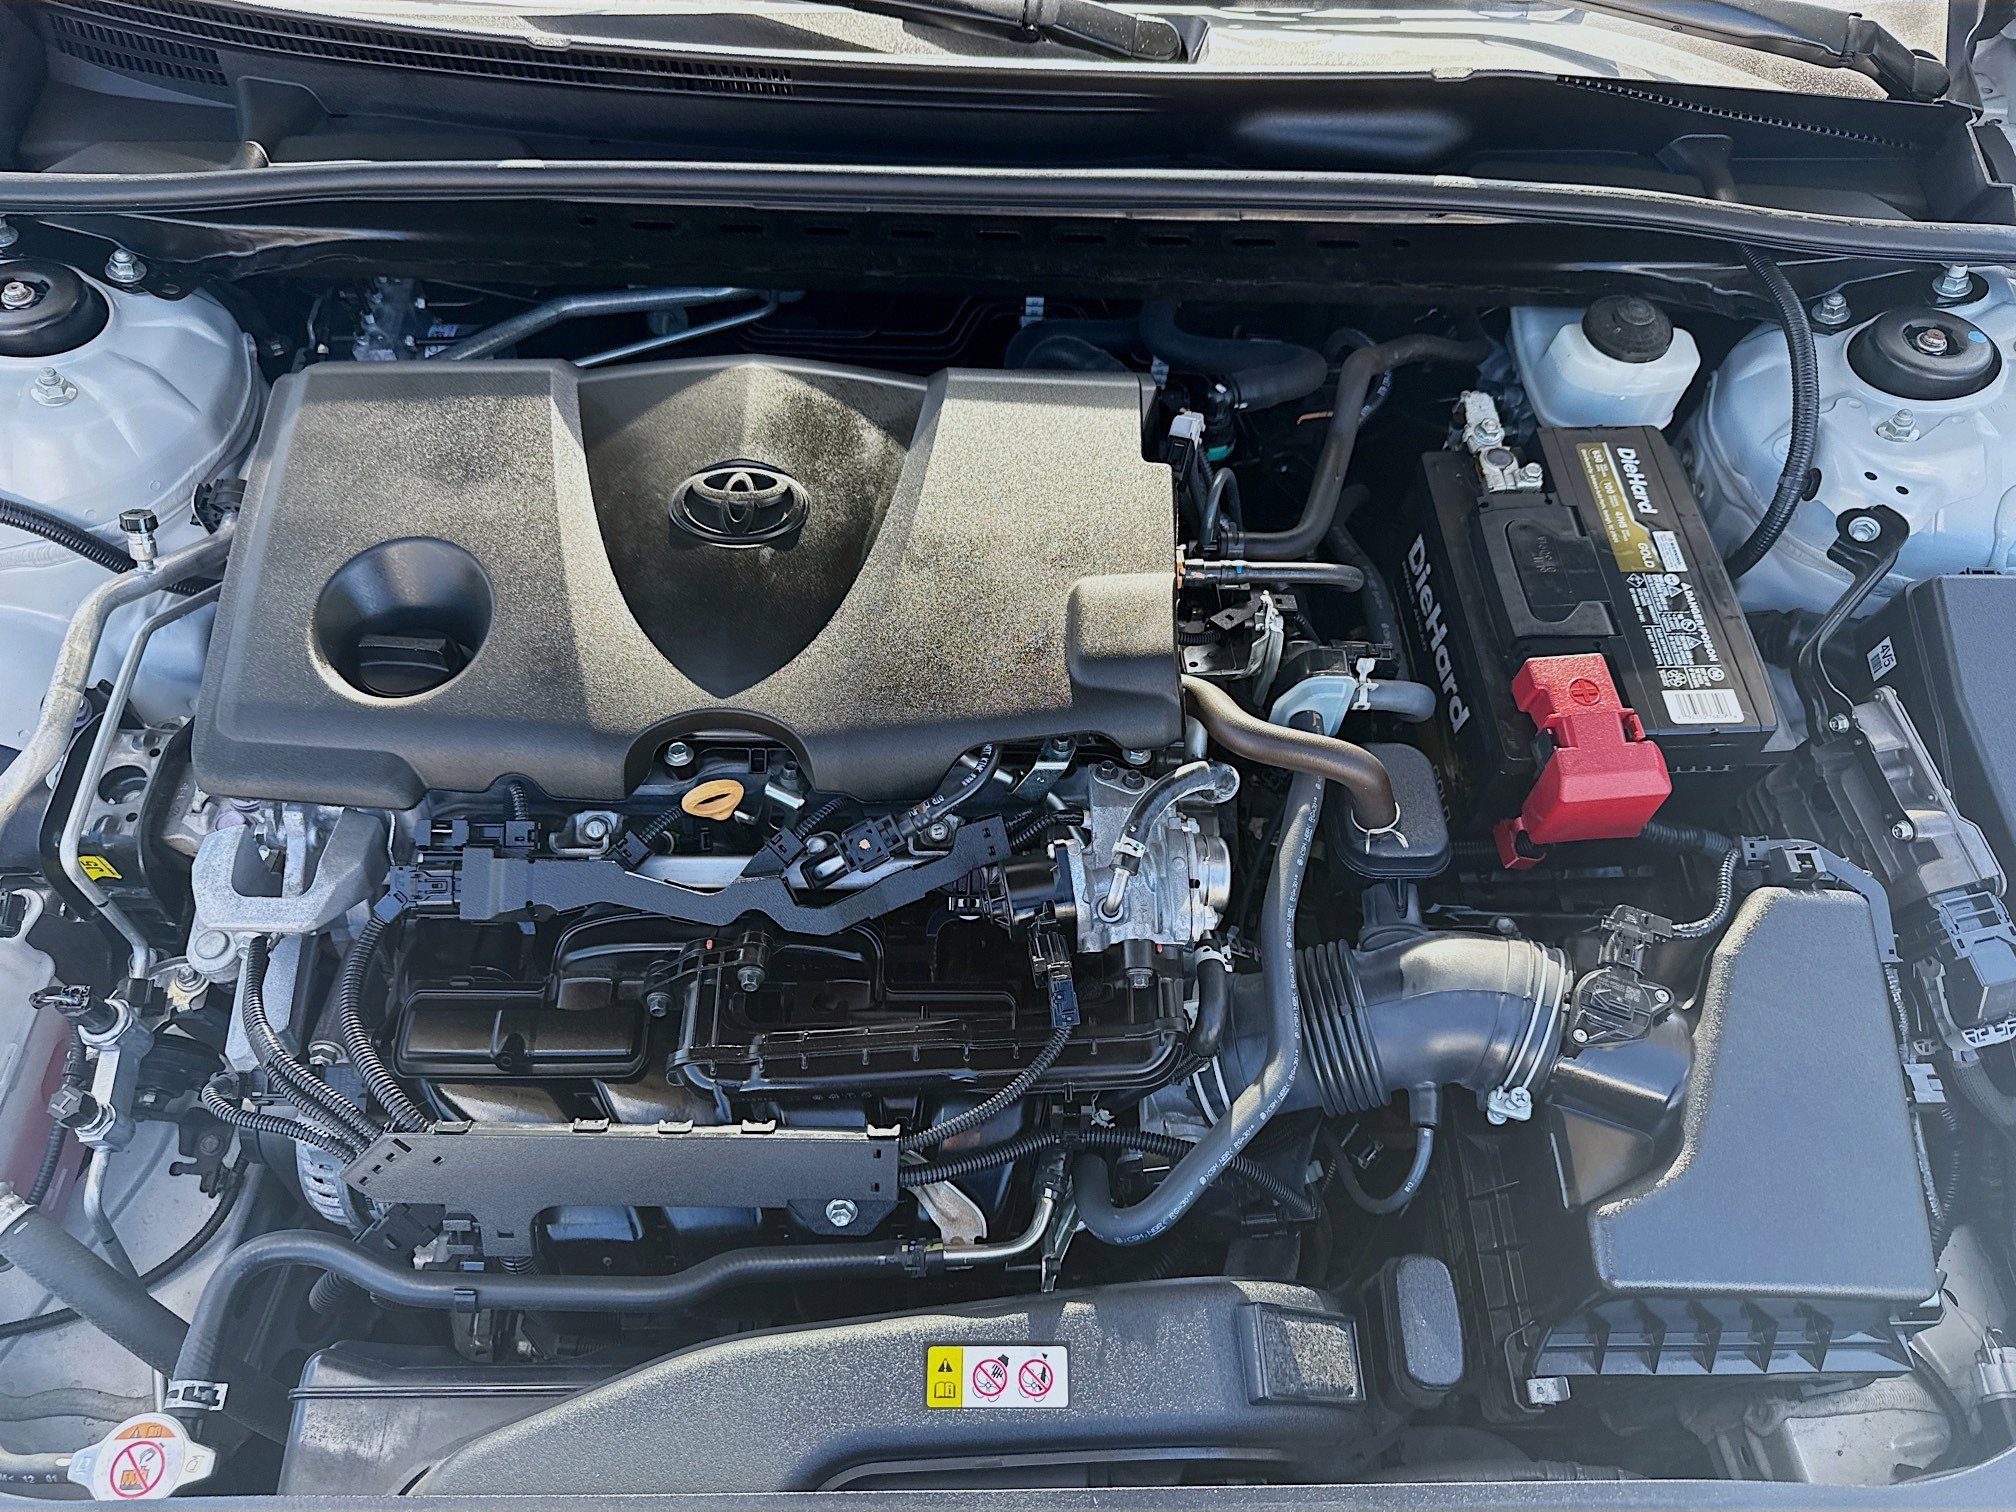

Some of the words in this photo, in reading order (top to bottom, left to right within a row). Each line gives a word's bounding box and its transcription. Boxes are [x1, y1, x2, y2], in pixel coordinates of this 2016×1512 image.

[1616, 447, 1659, 514] DieHard
[1637, 542, 1655, 568] GOLD
[1407, 533, 1470, 735] DieHard
[1881, 644, 1894, 667] 4V5
